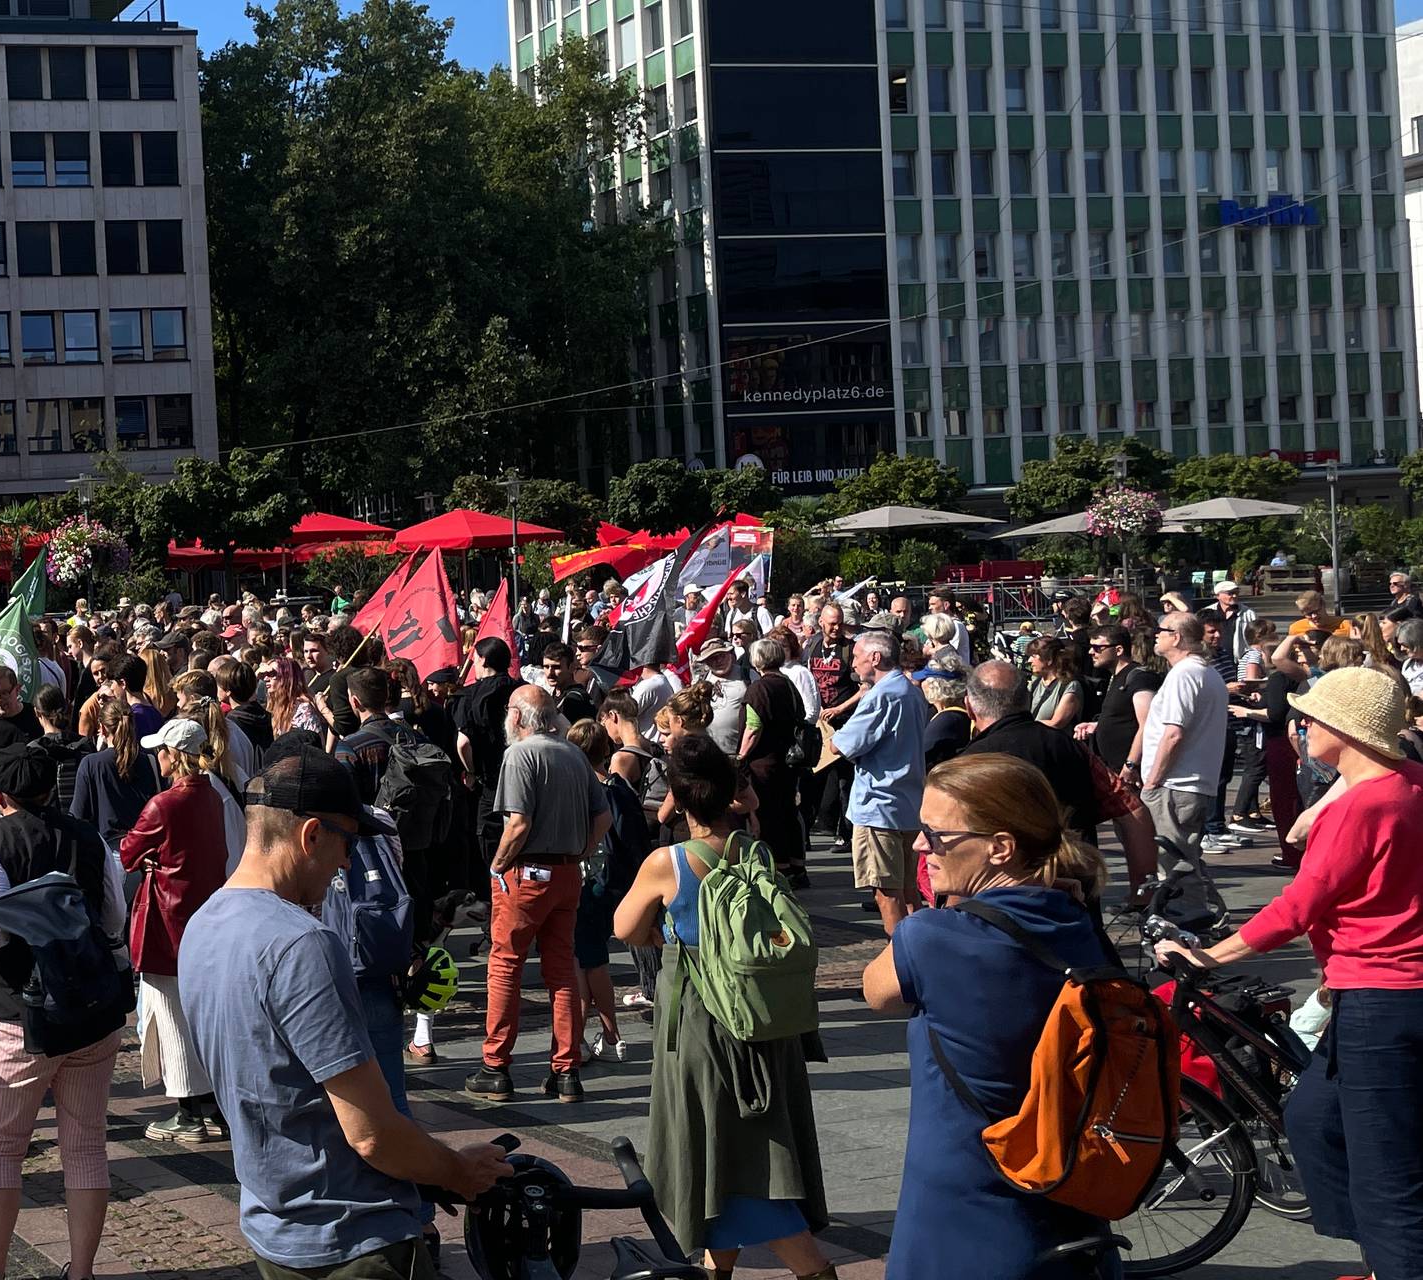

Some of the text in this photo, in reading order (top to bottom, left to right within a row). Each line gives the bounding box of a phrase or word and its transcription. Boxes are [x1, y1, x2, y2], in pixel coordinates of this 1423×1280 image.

[743, 385, 885, 404] kennedyplatz6.de
[771, 469, 791, 485] FÜR
[792, 469, 813, 484] LEIB
[815, 468, 835, 482] UND
